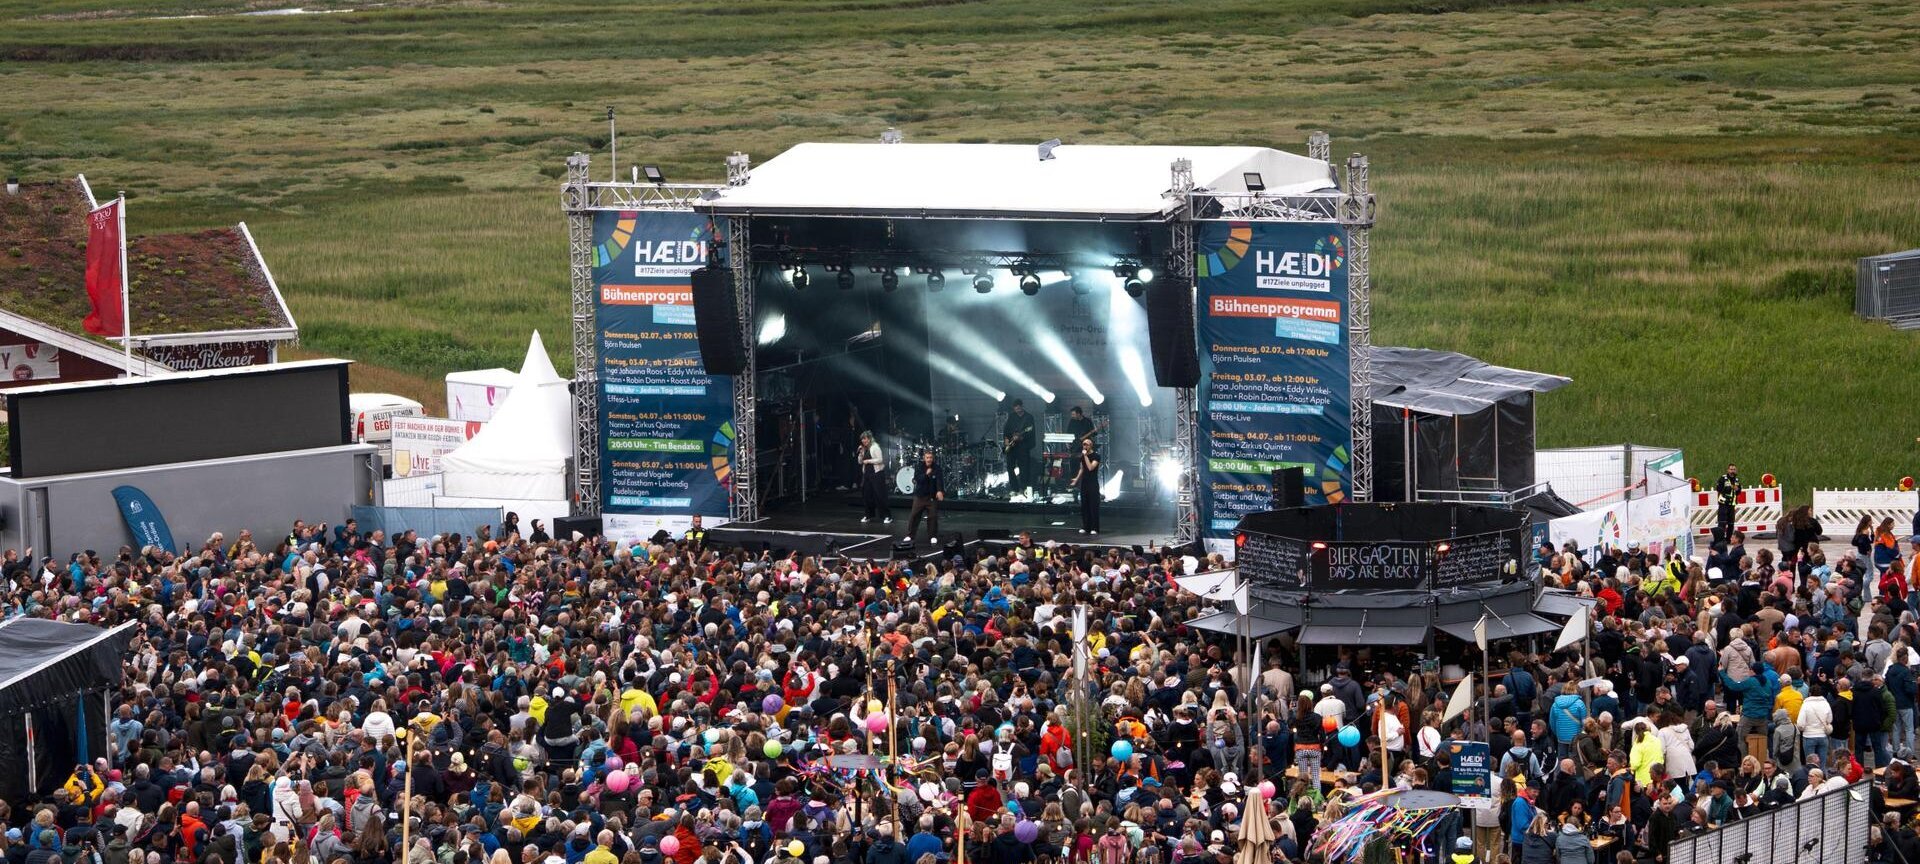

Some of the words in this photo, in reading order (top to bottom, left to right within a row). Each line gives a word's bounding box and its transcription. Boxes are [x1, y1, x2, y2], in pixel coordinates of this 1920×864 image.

[635, 240, 706, 262] HÆDI
[1256, 250, 1330, 276] HÆDI
[1262, 279, 1290, 287] #17Ziele
[1292, 280, 1325, 290] unplugged
[603, 288, 694, 304] Bühnenprogra
[1214, 298, 1336, 318] Bühnenprogramm
[1212, 344, 1259, 354] Donnerstag,
[1260, 346, 1284, 354] 02.07.,
[198, 350, 254, 369] Pilsener
[1212, 354, 1232, 363] Björn
[1234, 355, 1261, 363] Paulsen
[691, 378, 712, 386] Apple
[1212, 372, 1242, 382] Freitag,
[1244, 374, 1270, 382] 03.07.,
[1212, 382, 1228, 390] Inga
[1230, 383, 1262, 392] Johanna
[1286, 386, 1304, 394] Eddy
[1261, 394, 1284, 402] Damn
[1310, 397, 1330, 405] Apple
[610, 430, 629, 438] Poetry
[1212, 431, 1245, 440] Samstag,
[1264, 443, 1292, 451] Quintex
[1212, 451, 1236, 460] Poetry
[658, 480, 688, 489] Lebendig
[1212, 482, 1244, 492] Sonntag,
[1214, 501, 1226, 509] Paul
[1228, 502, 1258, 510] Eastham
[1328, 545, 1420, 566] BIERGARTEN
[1329, 566, 1356, 580] DAYS
[1358, 566, 1380, 578] ARE
[1384, 566, 1411, 579] BACK
